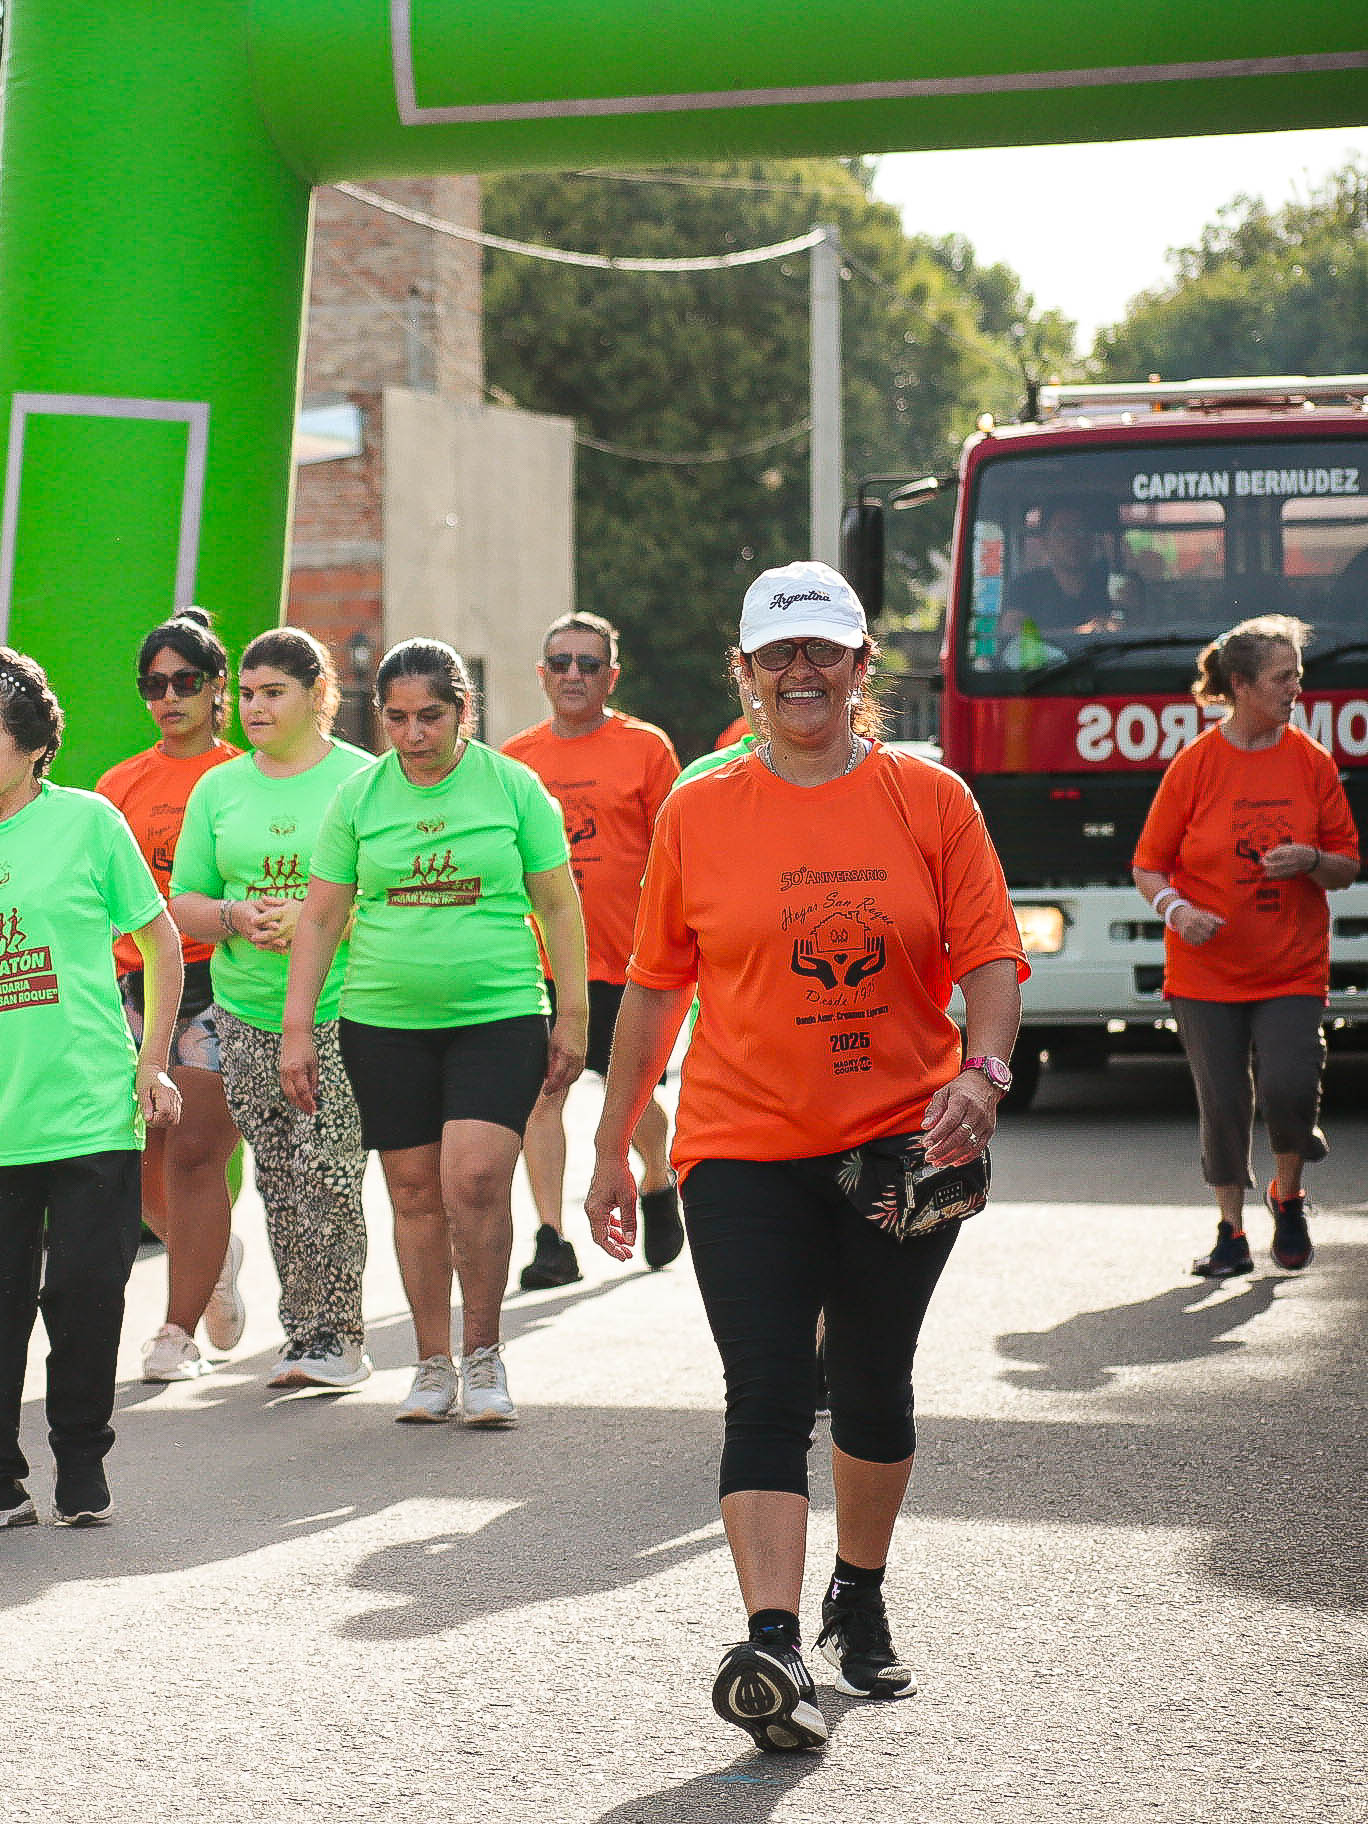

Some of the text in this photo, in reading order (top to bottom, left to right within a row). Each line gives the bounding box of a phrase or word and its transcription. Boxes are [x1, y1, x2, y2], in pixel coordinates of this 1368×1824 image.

[1132, 467, 1361, 499] CAPITAN BERMUDEZ
[768, 590, 832, 611] Argentina
[829, 1031, 871, 1054] 2025
